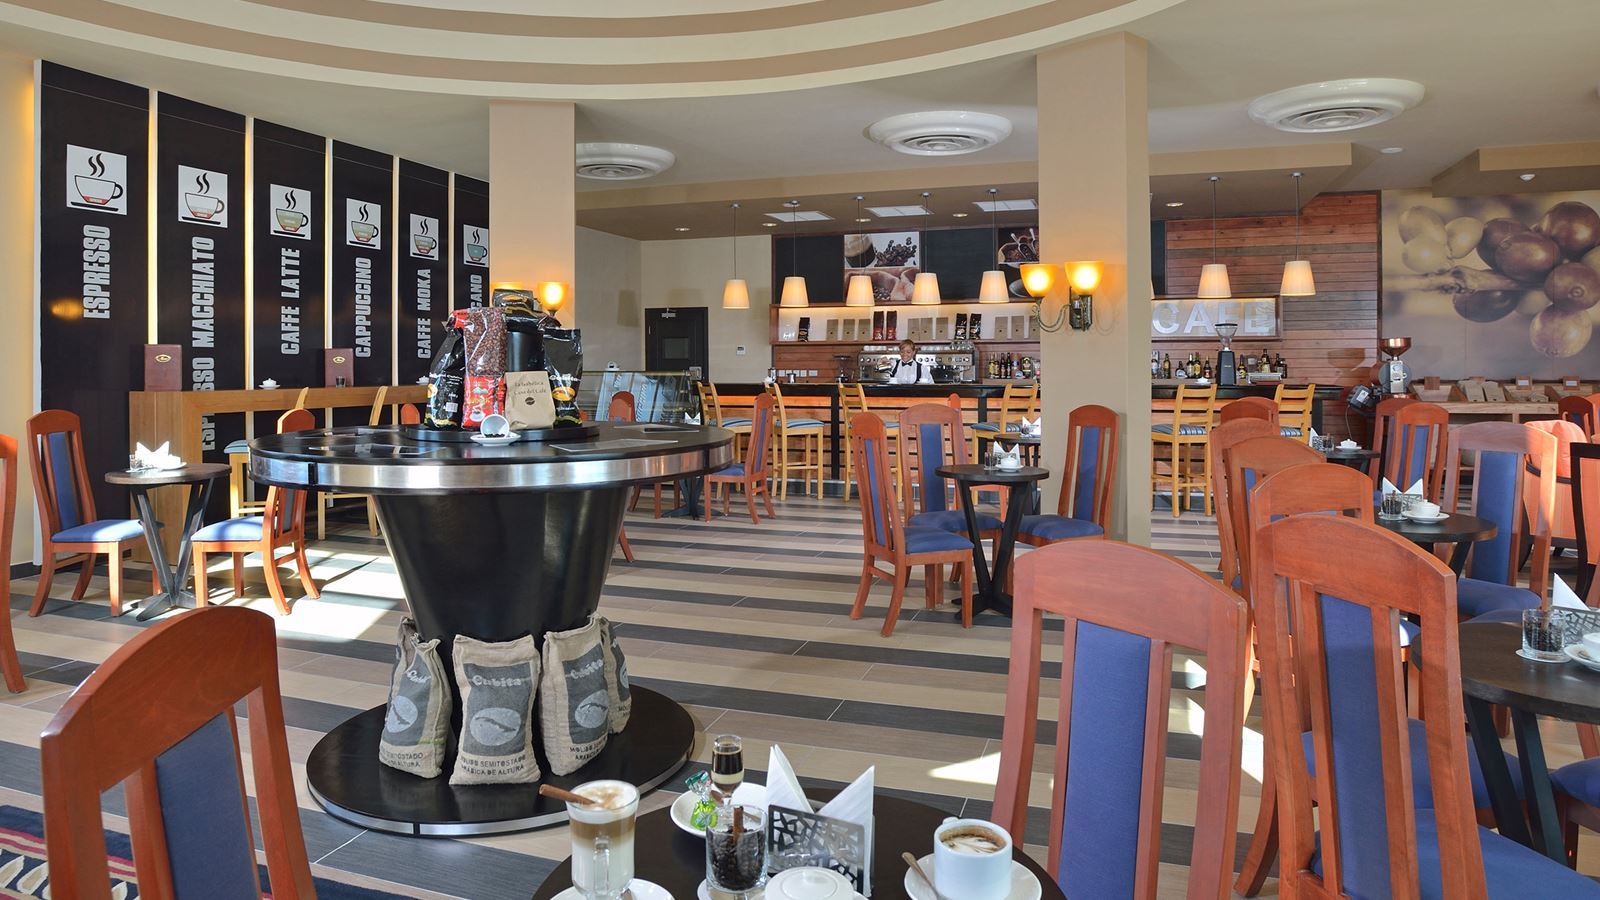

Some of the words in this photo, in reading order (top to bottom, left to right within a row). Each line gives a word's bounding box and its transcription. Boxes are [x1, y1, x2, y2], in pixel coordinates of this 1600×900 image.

[83, 225, 110, 318] ESPRESSO
[191, 236, 215, 348] MACCHIATO
[281, 247, 300, 299] LATTE
[417, 268, 431, 312] MOKA
[281, 305, 300, 355] CAFFE
[355, 257, 372, 358] CAPPUCCINO
[417, 317, 432, 359] CAFFE
[192, 357, 216, 451] ESPSSO
[471, 674, 523, 687] Cubita
[498, 763, 525, 776] ALTURA
